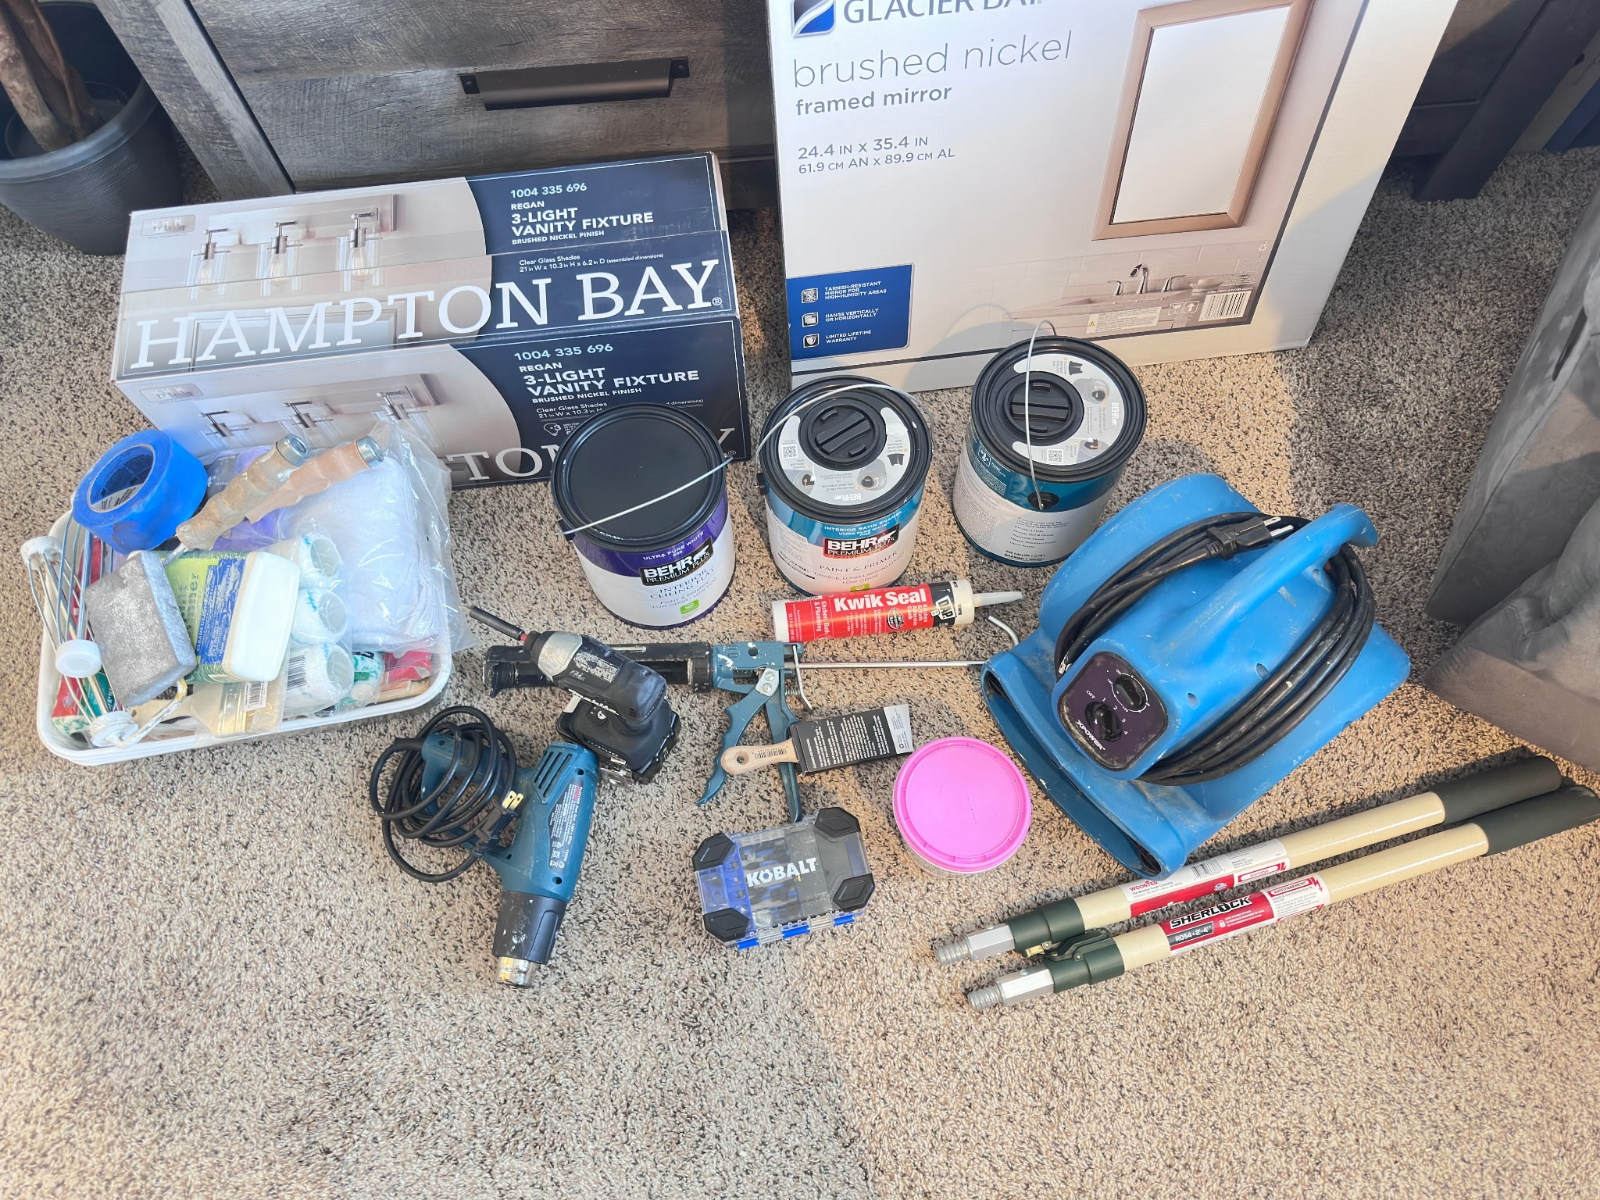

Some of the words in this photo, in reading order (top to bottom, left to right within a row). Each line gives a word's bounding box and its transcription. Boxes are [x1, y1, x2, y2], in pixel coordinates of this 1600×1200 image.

[793, 43, 948, 88] brushed
[964, 30, 1072, 69] nickel
[796, 91, 875, 115] framed
[883, 85, 952, 106] mirror
[798, 144, 834, 159] 24.4
[839, 145, 853, 154] IN
[873, 136, 909, 151] 35.4
[915, 137, 928, 146] IN
[798, 162, 825, 174] 61.9
[828, 161, 844, 171] CM
[848, 157, 869, 168] AN
[884, 152, 914, 164] 89.9
[917, 152, 933, 161] CM
[937, 148, 955, 159] AL
[510, 186, 538, 199] 1004
[542, 184, 563, 196] 335
[566, 182, 588, 194] 696
[510, 200, 545, 211] REGAN
[511, 208, 578, 225] 3-LIGHT
[511, 220, 576, 237] VANITY
[582, 212, 654, 230] FIXTURE
[511, 236, 548, 245] BRUSHED
[549, 232, 577, 241] NICKEL
[579, 230, 605, 238] FINISH
[519, 258, 537, 266] Clear
[537, 256, 555, 264] Glass
[556, 254, 581, 263] Shades
[130, 278, 552, 369] HAMPTON
[514, 349, 551, 361] 1004
[555, 346, 582, 358] 335
[587, 343, 614, 354] 696
[519, 362, 563, 373] REGAN
[523, 368, 606, 385] 3-LIGHT
[527, 380, 606, 397] VANITY
[613, 370, 700, 389] FIXTURE
[532, 395, 575, 404] BRUSHED
[577, 391, 610, 399] NICKEL
[612, 388, 642, 396] FINISH
[536, 406, 557, 414] Clear
[558, 404, 581, 412] Glass
[827, 536, 879, 551] BEHR
[827, 547, 872, 556] PREMIUM
[644, 555, 693, 578] BEHR
[646, 567, 690, 583] PREMIUM
[834, 593, 884, 612] Kwik
[885, 588, 927, 606] Seal
[745, 857, 817, 888] KOBALT
[1170, 895, 1252, 928] SHERLOCK
